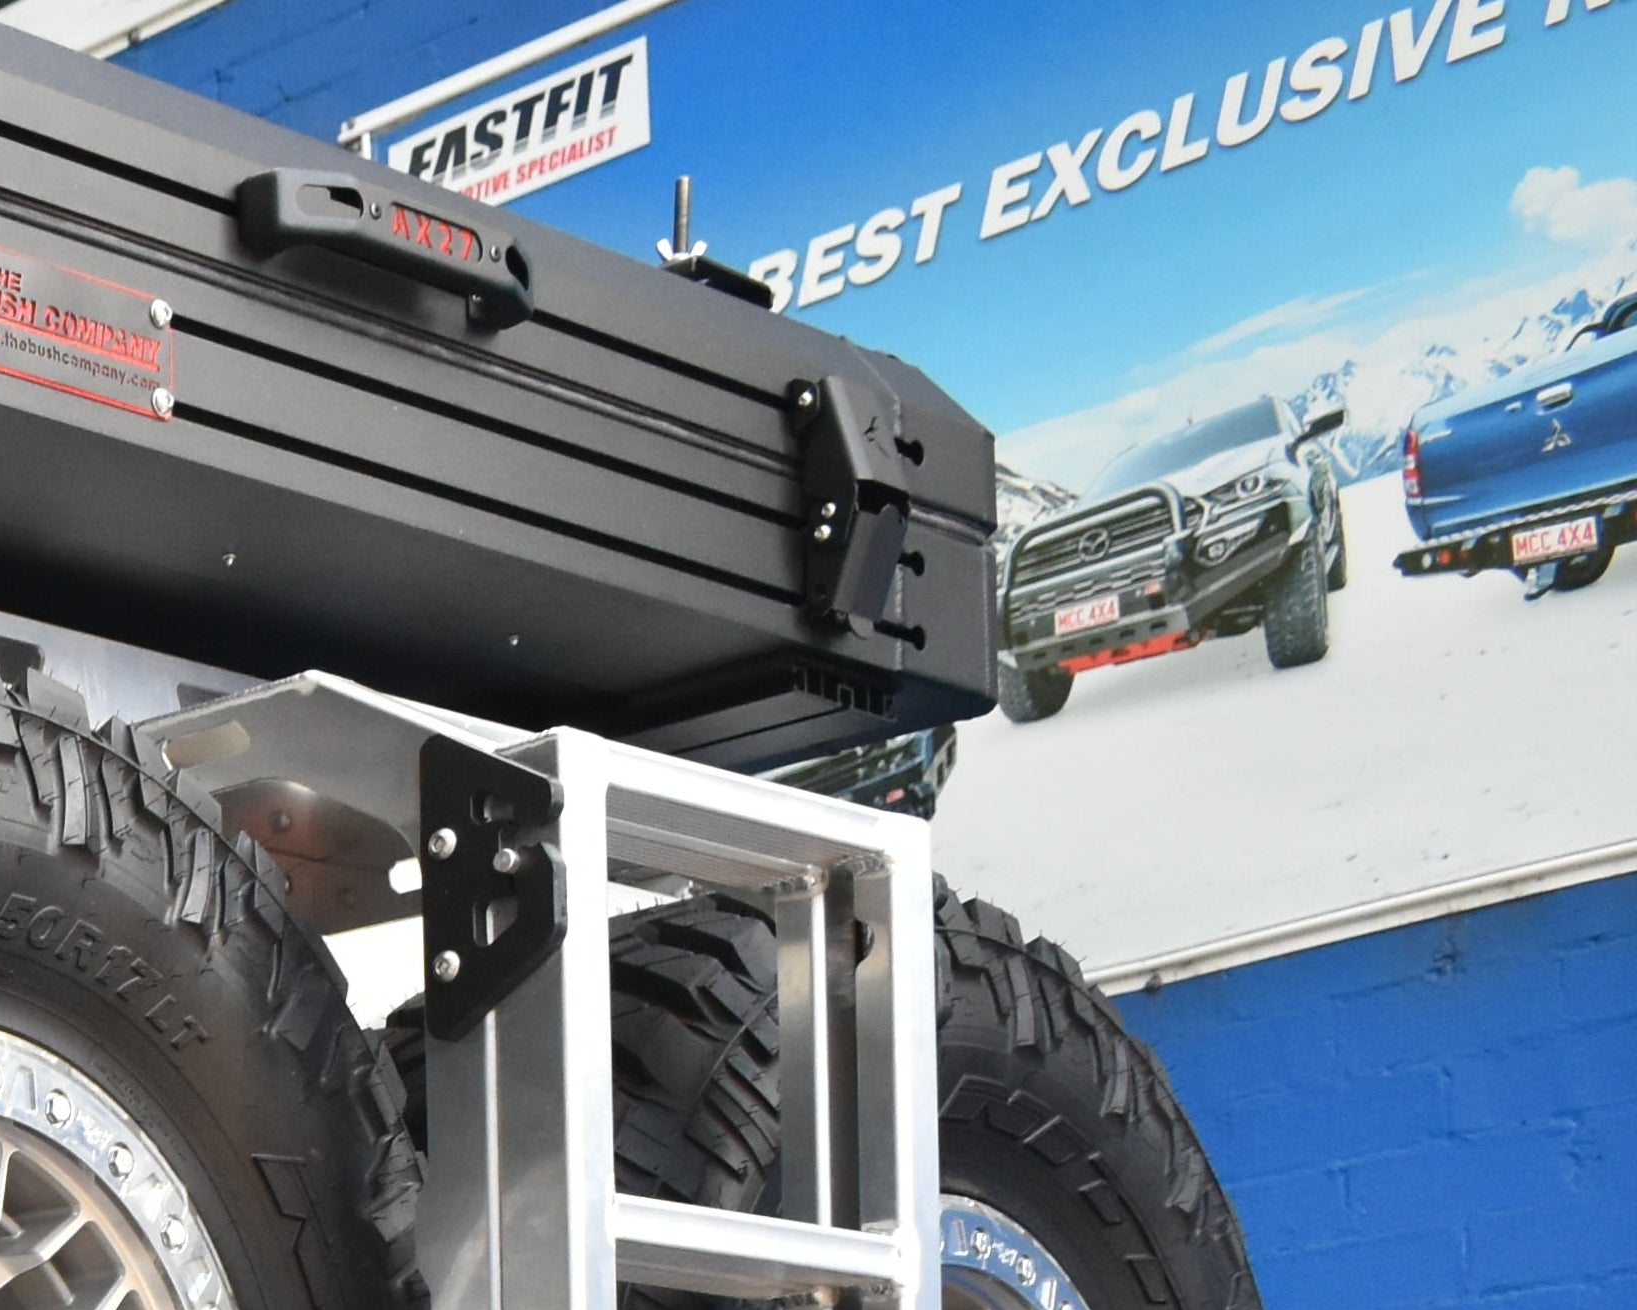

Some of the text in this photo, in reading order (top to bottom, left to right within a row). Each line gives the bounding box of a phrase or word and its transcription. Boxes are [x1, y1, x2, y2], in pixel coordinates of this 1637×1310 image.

[408, 54, 634, 182] FASTFIT
[516, 126, 617, 184] SPECIALIST
[749, 0, 1507, 314] BEST EXCLUSIVE
[392, 206, 474, 260] AX27
[44, 305, 161, 366] COMPANY
[1514, 519, 1596, 557] MCC 4X4
[1057, 599, 1117, 632] MCC 4X4
